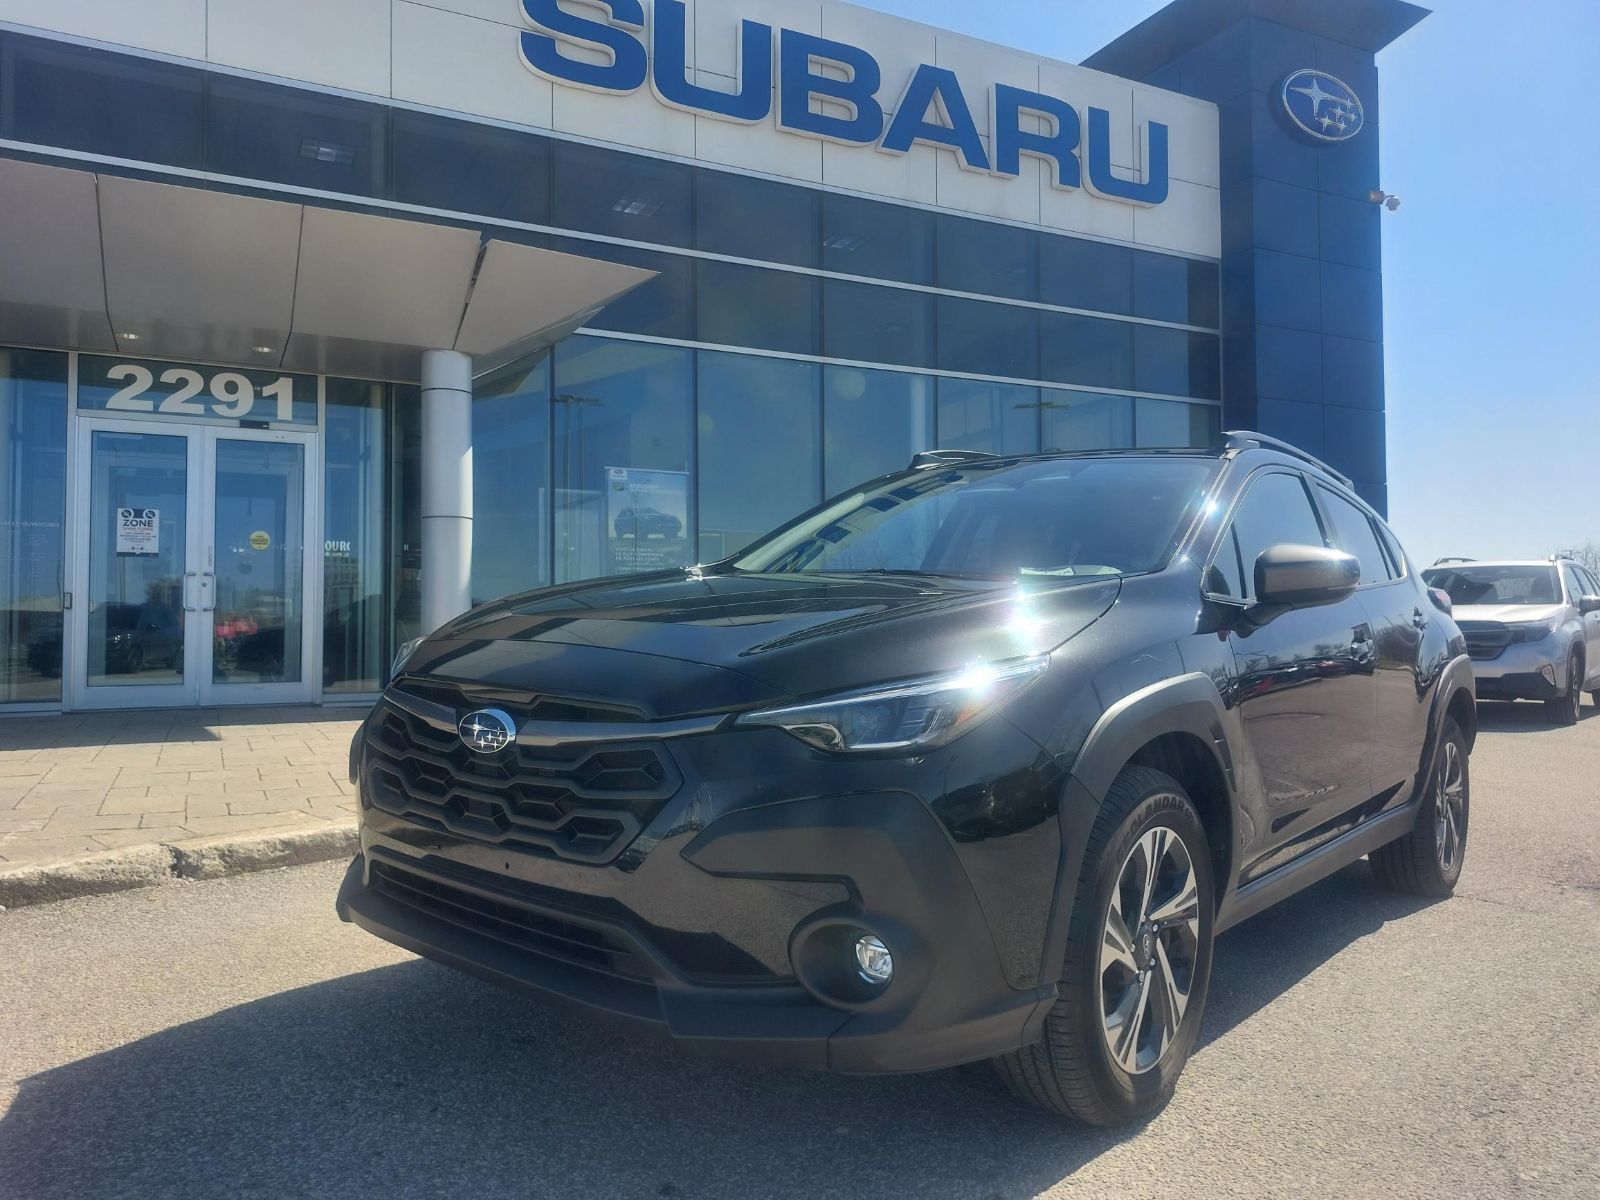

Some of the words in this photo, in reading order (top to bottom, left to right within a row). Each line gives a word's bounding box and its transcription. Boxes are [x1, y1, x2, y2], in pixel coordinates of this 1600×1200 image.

[519, 0, 1169, 206] SUBARU
[106, 365, 293, 421] 2291
[122, 519, 154, 528] ZONE
